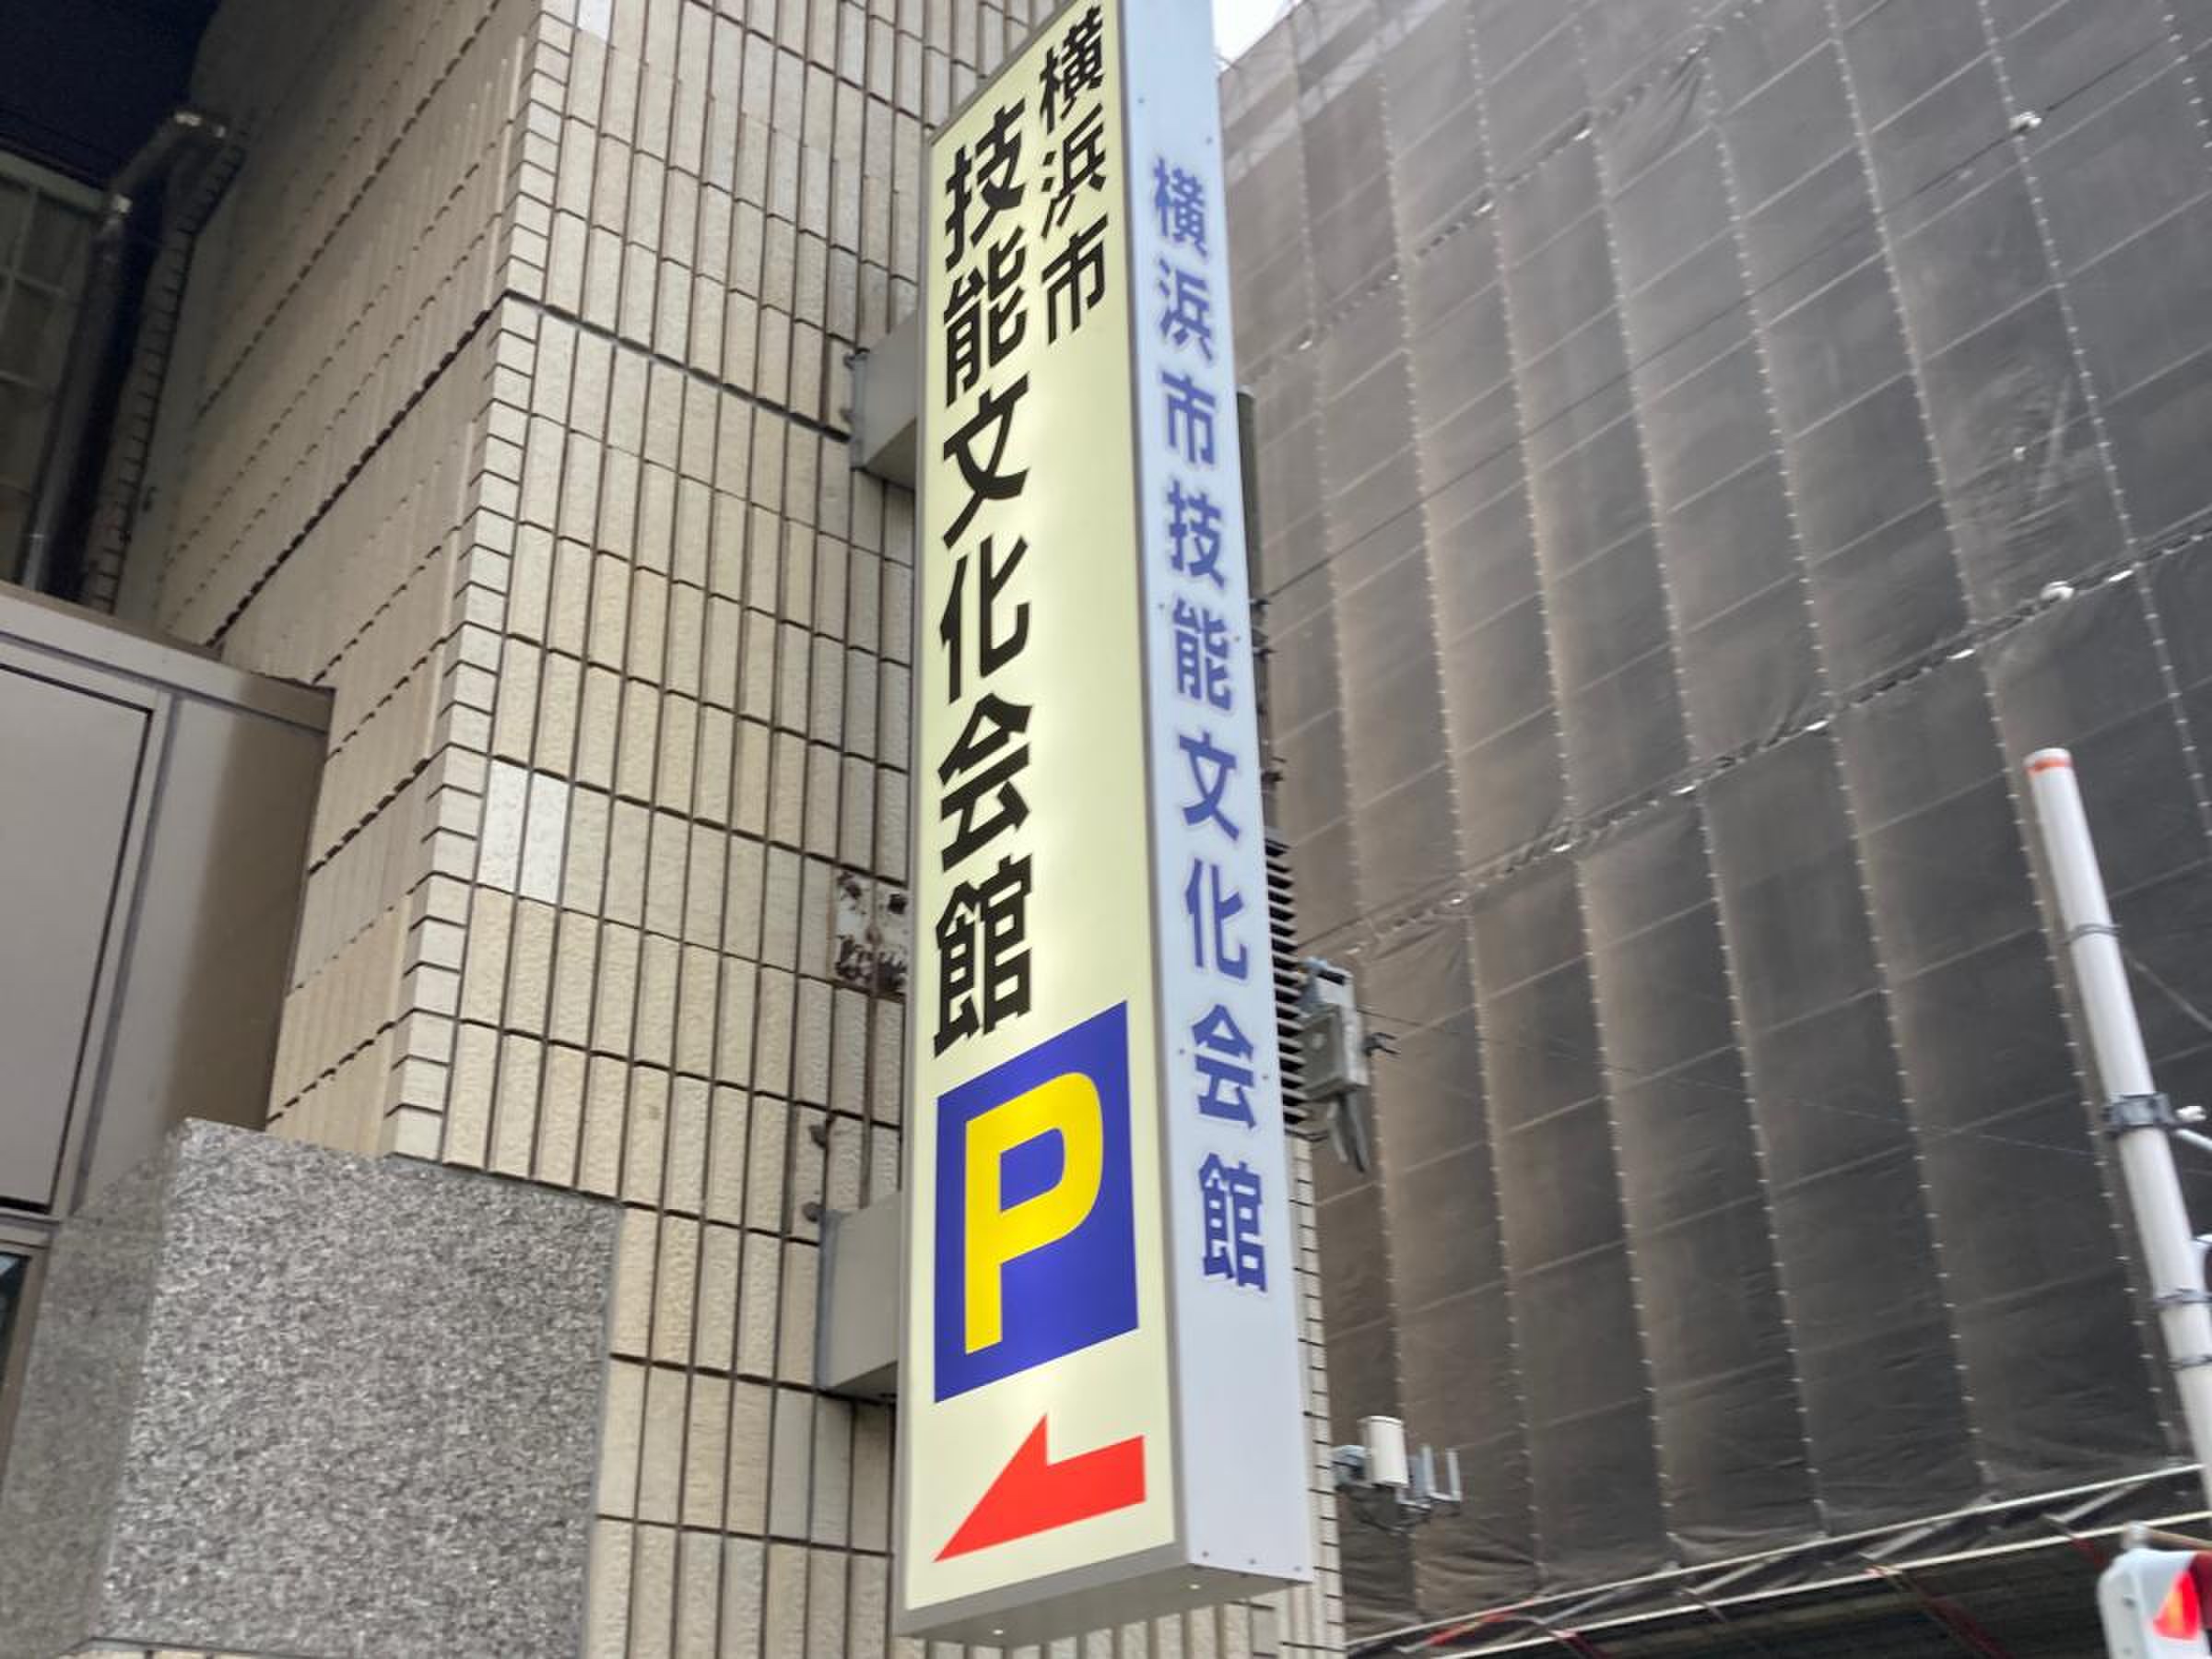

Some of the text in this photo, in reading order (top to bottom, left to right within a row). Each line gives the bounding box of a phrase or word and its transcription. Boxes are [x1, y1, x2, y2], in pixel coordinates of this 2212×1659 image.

[1039, 5, 1109, 346] 横浜市
[934, 98, 1032, 1059] 技能文化会館
[1152, 154, 1267, 1293] 横浜市技能文化会館
[964, 1072, 1103, 1356] P
